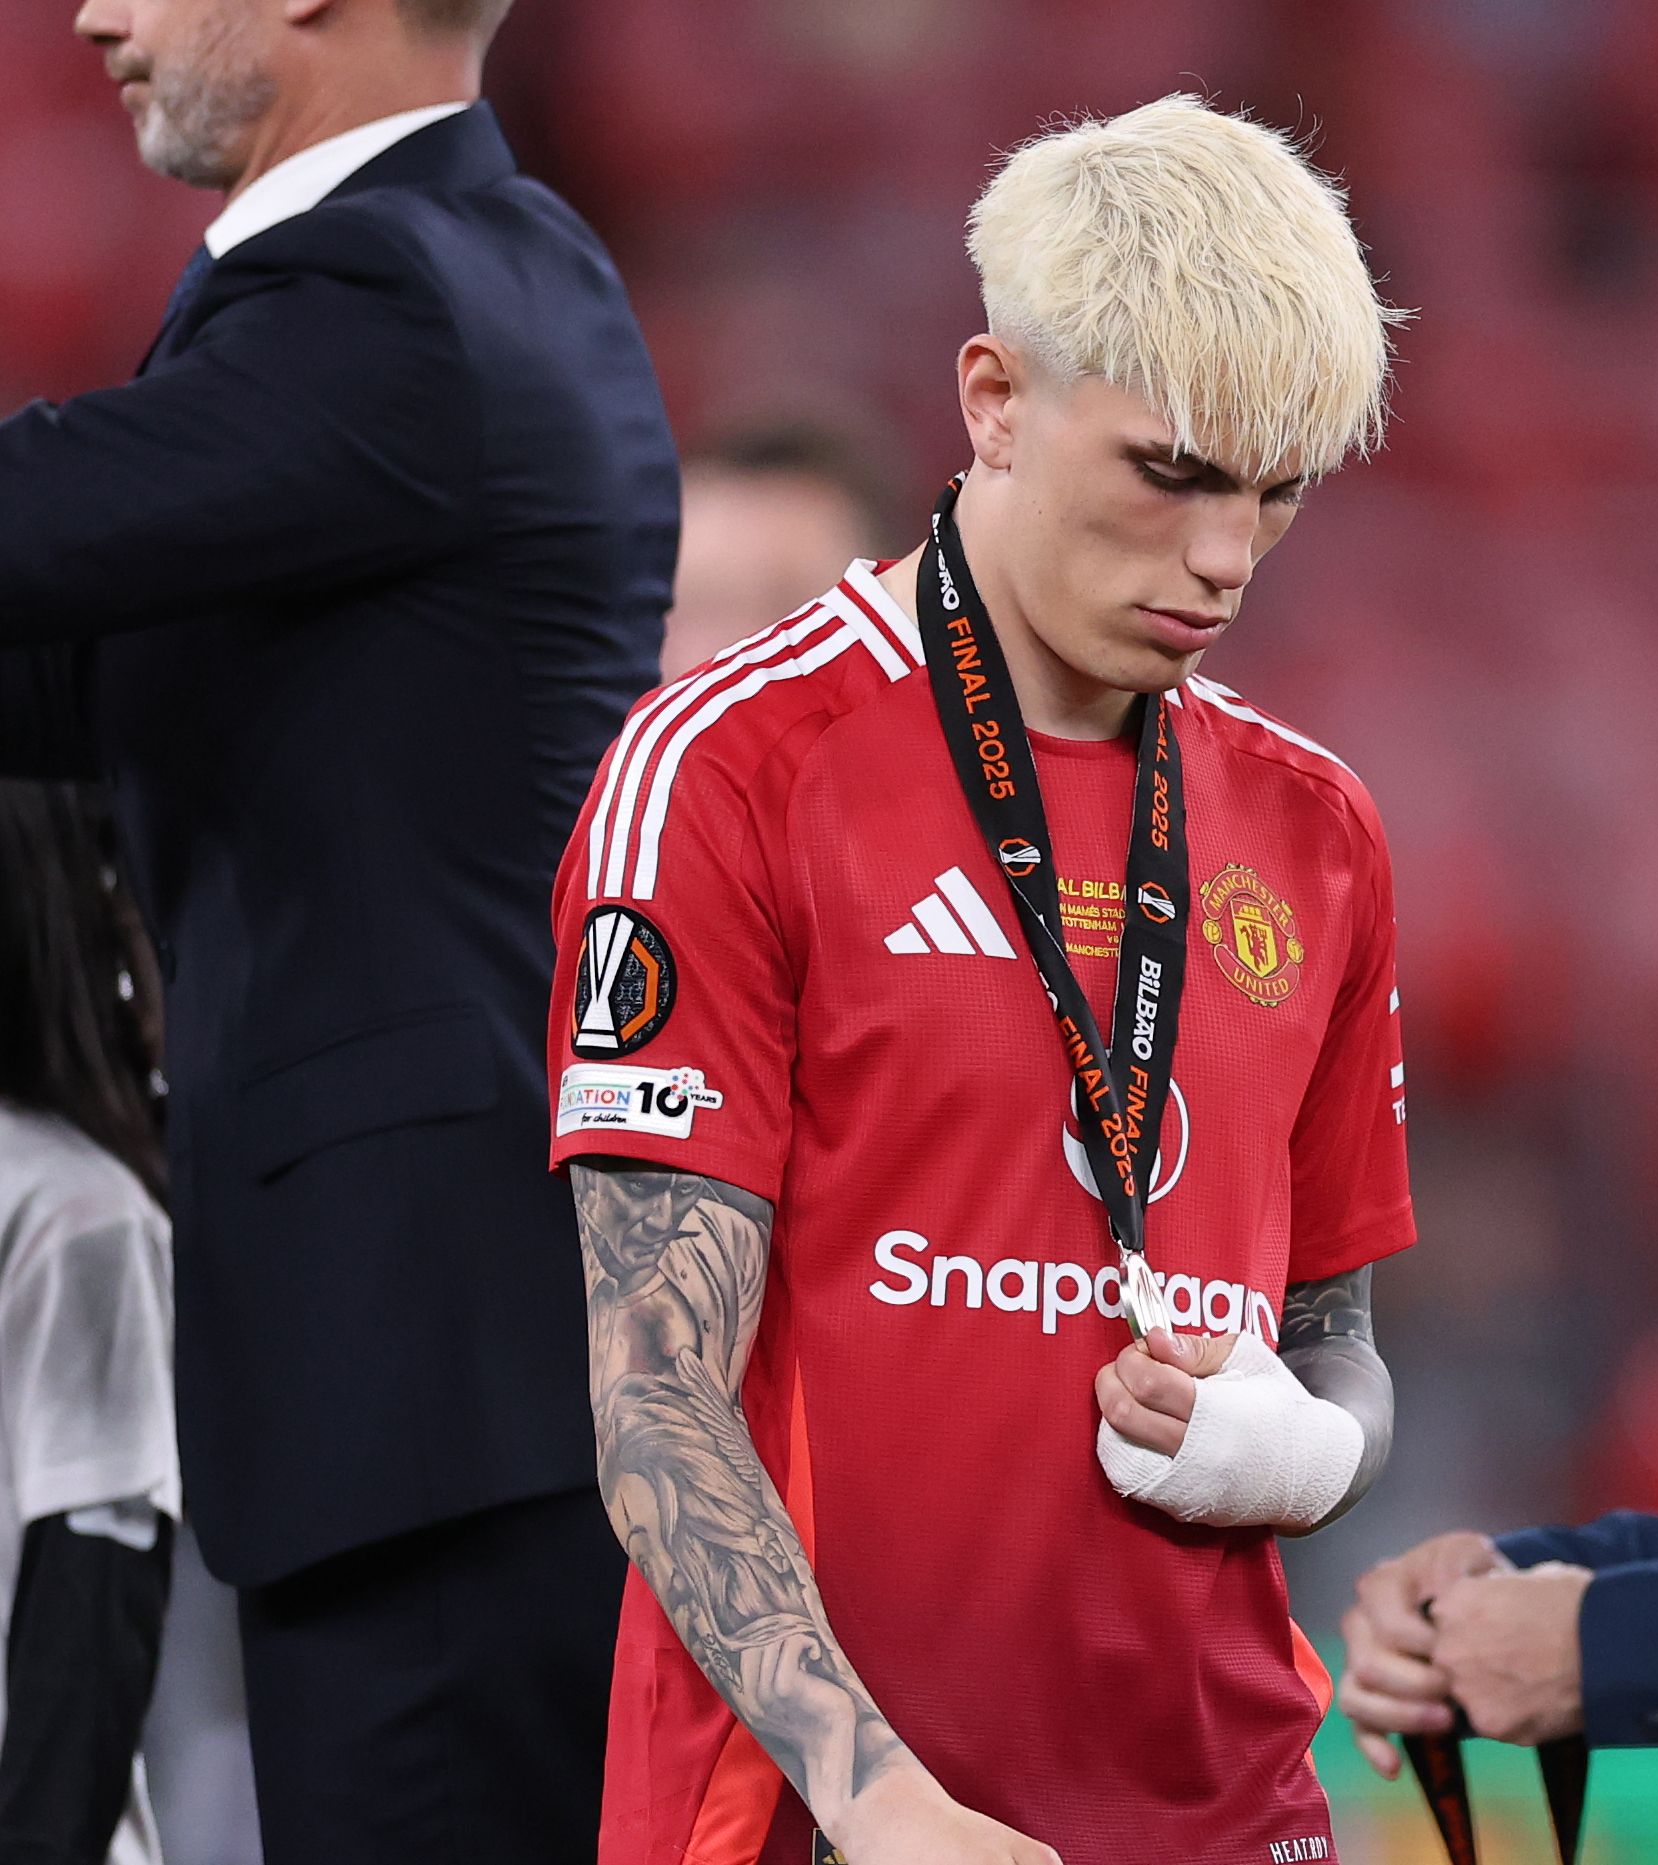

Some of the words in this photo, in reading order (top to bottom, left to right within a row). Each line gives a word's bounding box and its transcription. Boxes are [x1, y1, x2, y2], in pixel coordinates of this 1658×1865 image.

[947, 616, 991, 715] FINAL
[972, 719, 1016, 800] 2025
[1152, 770, 1169, 852] 2025
[1057, 877, 1080, 896] AL
[1209, 873, 1289, 928] MANCHESTER
[1061, 916, 1117, 931] TOTTENHAM
[1102, 908, 1126, 919] STAD
[1233, 967, 1289, 997] UNITED
[1059, 1015, 1110, 1112] FINAL
[635, 1081, 688, 1117] 10
[690, 1093, 717, 1104] YEARS
[581, 1112, 592, 1126] for
[593, 1113, 627, 1124] children
[1270, 1836, 1328, 1864] HEAT.RDY
